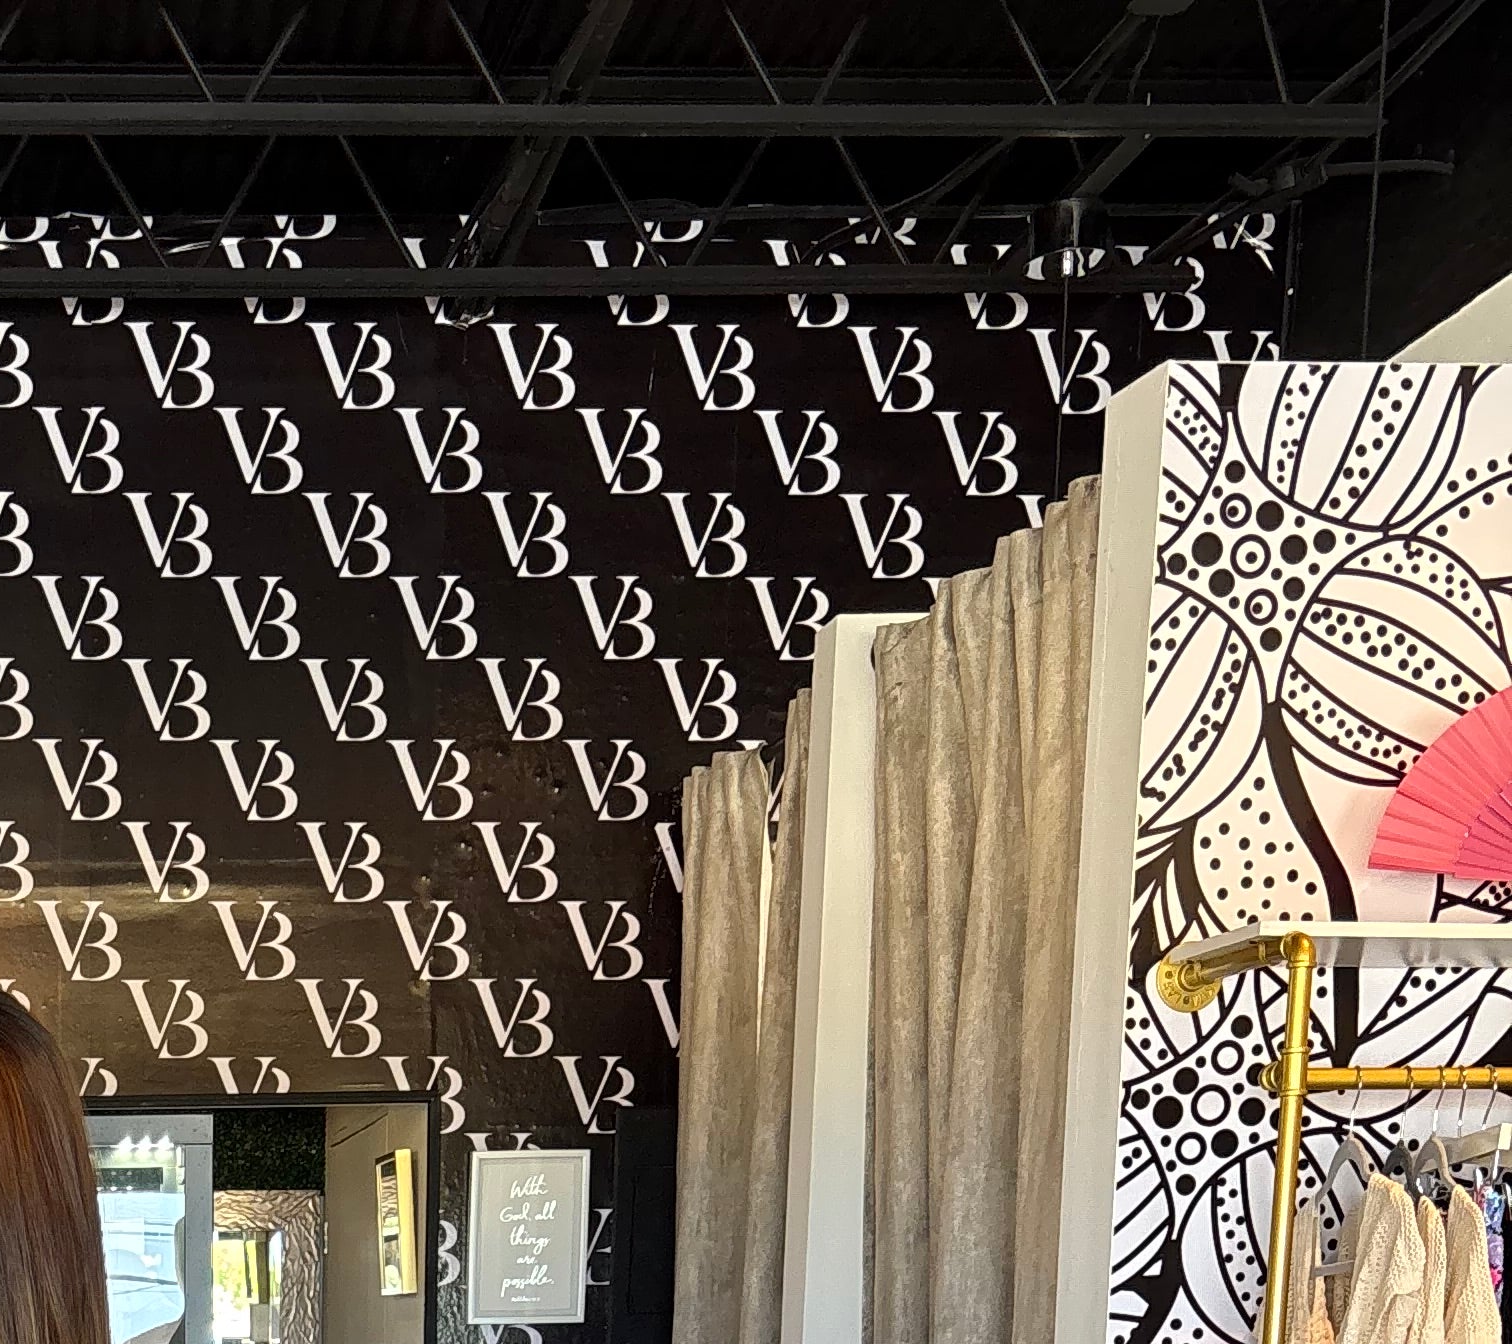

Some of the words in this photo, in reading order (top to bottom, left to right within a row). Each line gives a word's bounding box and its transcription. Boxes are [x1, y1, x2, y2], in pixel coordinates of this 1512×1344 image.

[124, 322, 214, 408] VB
[306, 322, 395, 409] VB
[487, 324, 575, 409] VB
[669, 325, 755, 410] VB
[848, 327, 934, 412] VB
[1026, 328, 1112, 415] VB
[33, 407, 123, 493] VB
[214, 408, 303, 494] VB
[394, 408, 482, 493] VB
[576, 409, 662, 494] VB
[753, 410, 840, 495] VB
[932, 412, 1018, 496] VB
[123, 493, 212, 577] VB
[302, 493, 390, 577] VB
[482, 492, 568, 577] VB
[661, 493, 747, 577] VB
[839, 494, 924, 578] VB
[33, 576, 122, 660] VB
[212, 576, 300, 660] VB
[390, 576, 477, 659] VB
[569, 576, 655, 659] VB
[746, 576, 830, 661] VB
[122, 659, 210, 741] VB
[300, 659, 387, 741] VB
[476, 658, 563, 741] VB
[654, 659, 738, 741] VB
[33, 739, 121, 821] VB
[210, 740, 297, 820] VB
[386, 739, 473, 820] VB
[564, 740, 648, 820] VB
[120, 821, 210, 903] VB
[297, 822, 384, 902] VB
[472, 822, 558, 902] VB
[33, 898, 121, 981] VB
[208, 901, 295, 980] VB
[383, 900, 469, 982] VB
[559, 901, 643, 980] VB
[121, 980, 208, 1058] VB
[295, 979, 381, 1057] VB
[469, 979, 553, 1057] VB
[509, 1173, 549, 1199] With
[534, 1200, 557, 1221] all
[510, 1224, 550, 1256] things
